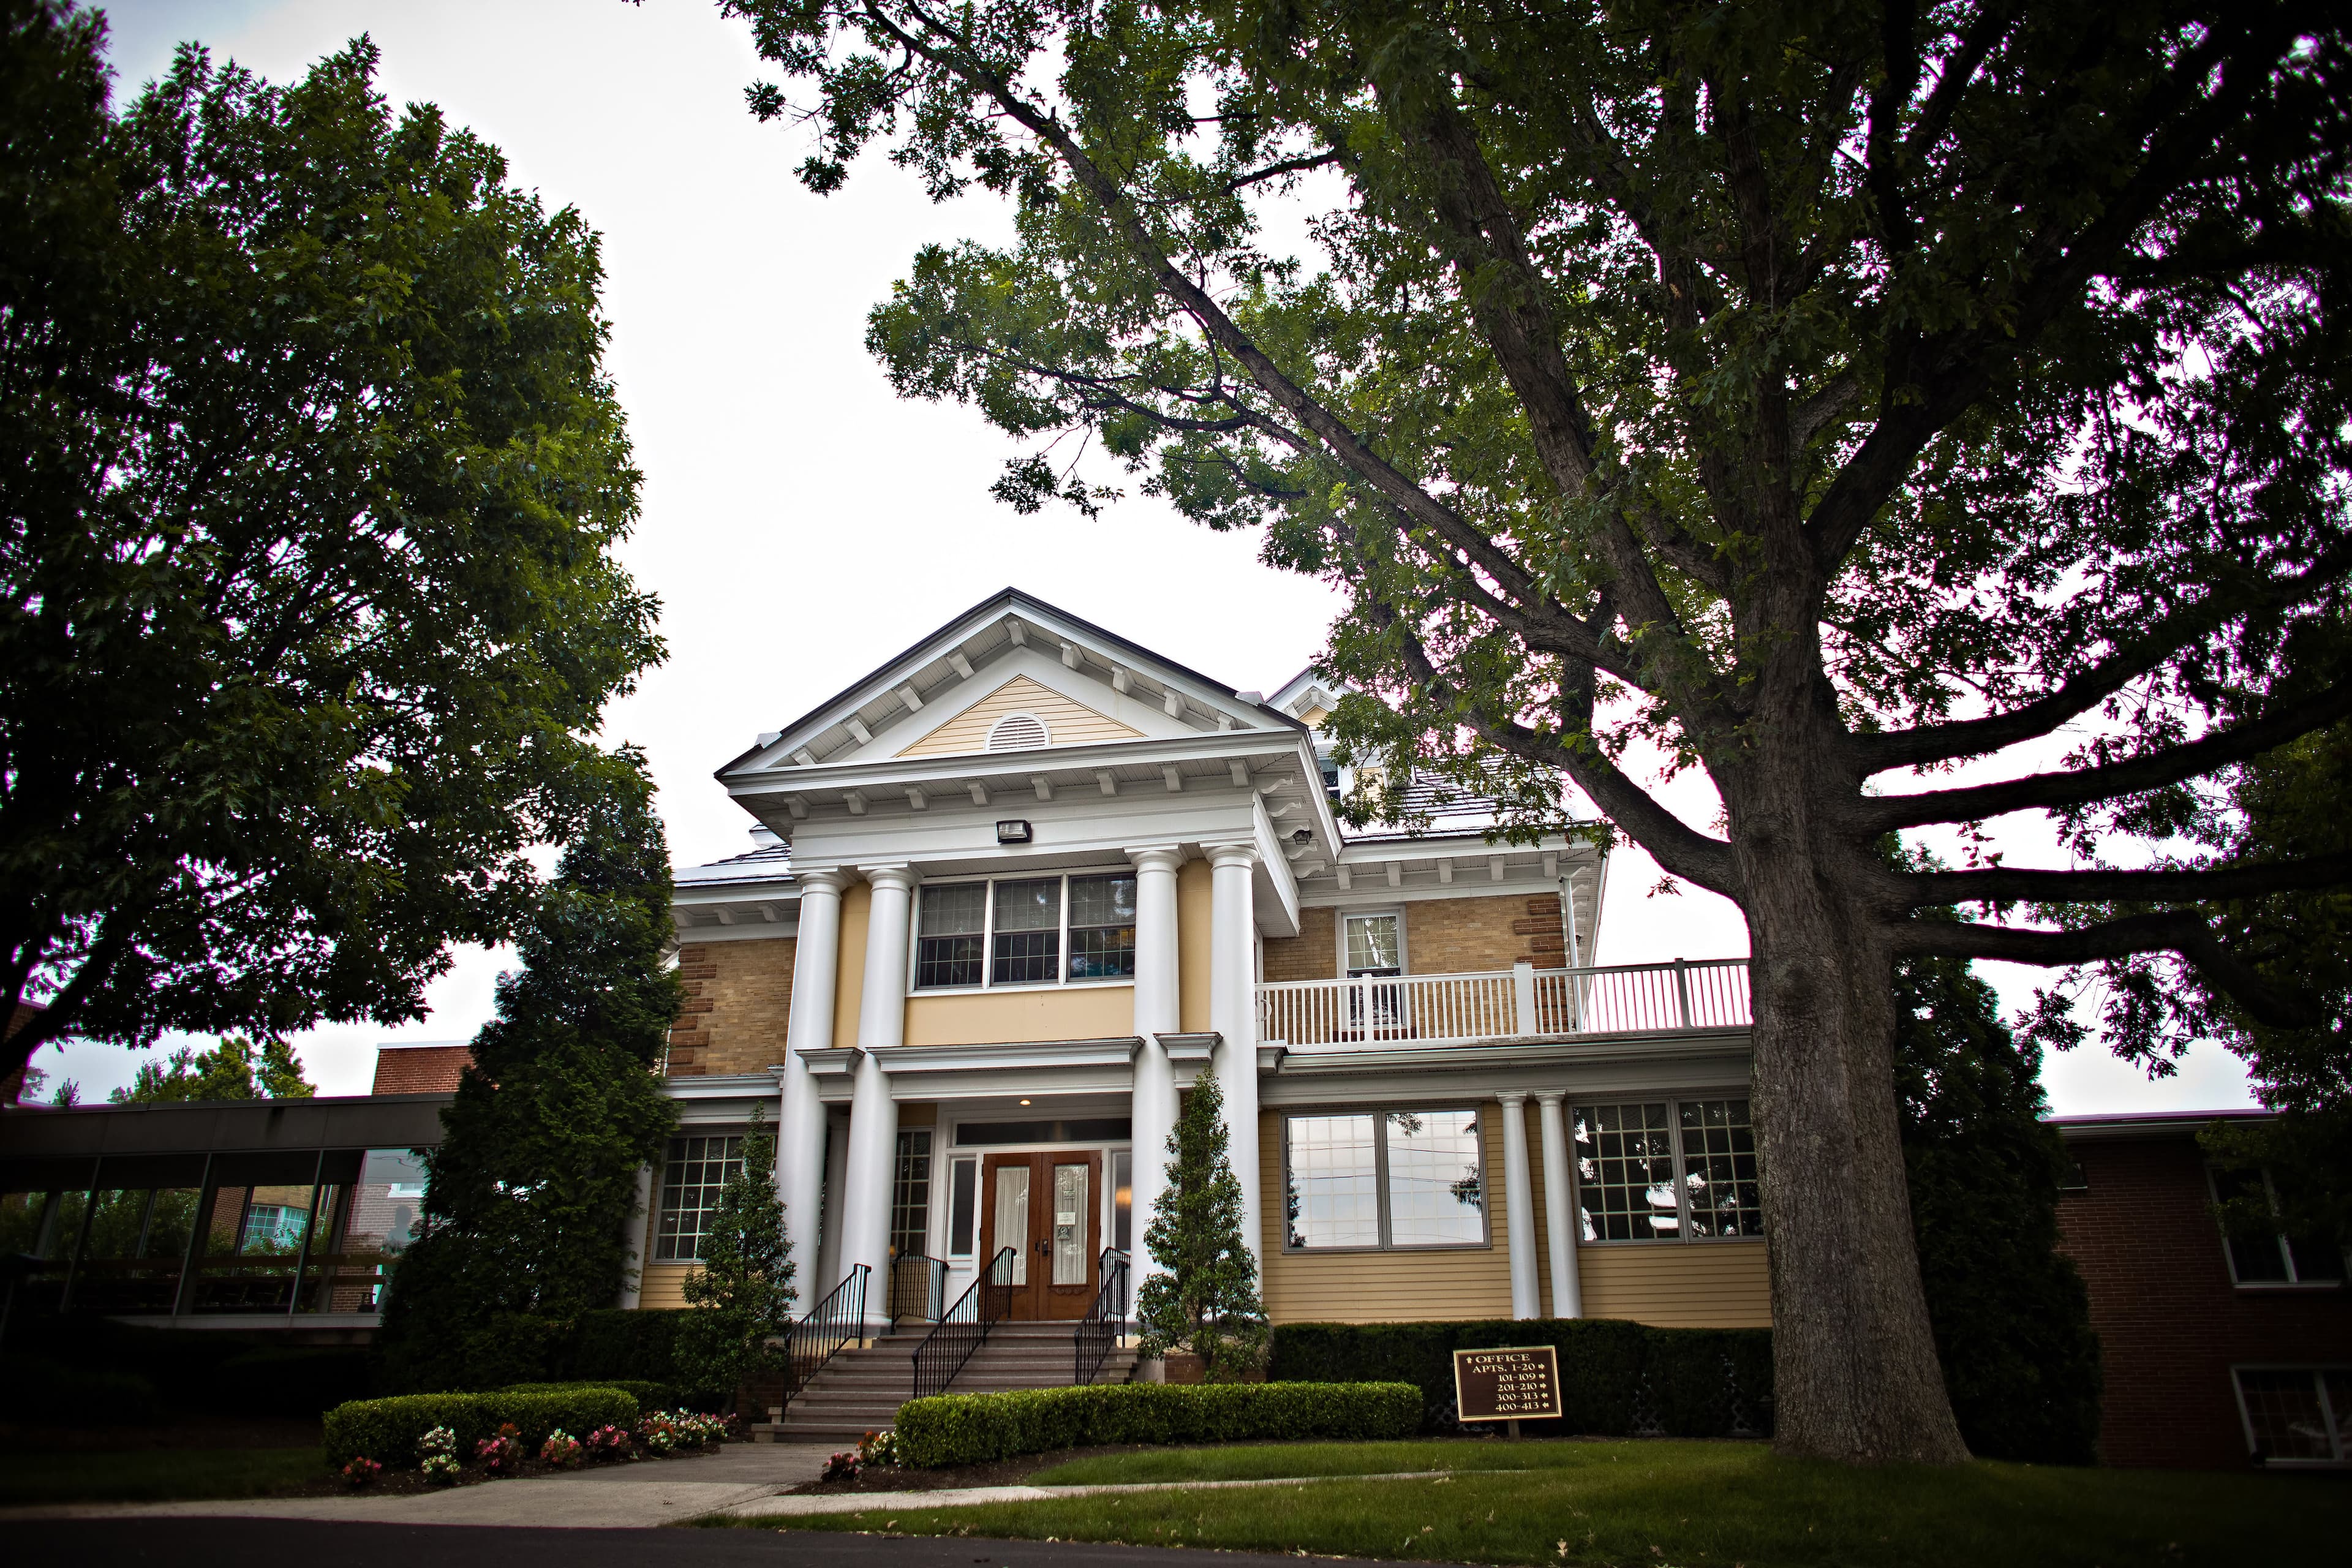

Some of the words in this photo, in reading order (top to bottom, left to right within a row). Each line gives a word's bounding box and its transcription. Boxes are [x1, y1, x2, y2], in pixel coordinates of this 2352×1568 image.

[1475, 1354, 1530, 1363] OFFICE
[1472, 1365, 1507, 1373] APTS.
[1512, 1363, 1536, 1371] 1-20
[1498, 1373, 1536, 1382] 101-109
[1497, 1382, 1537, 1392] 201-210
[1496, 1392, 1538, 1401] 300-313
[1495, 1401, 1539, 1412] 400-413
